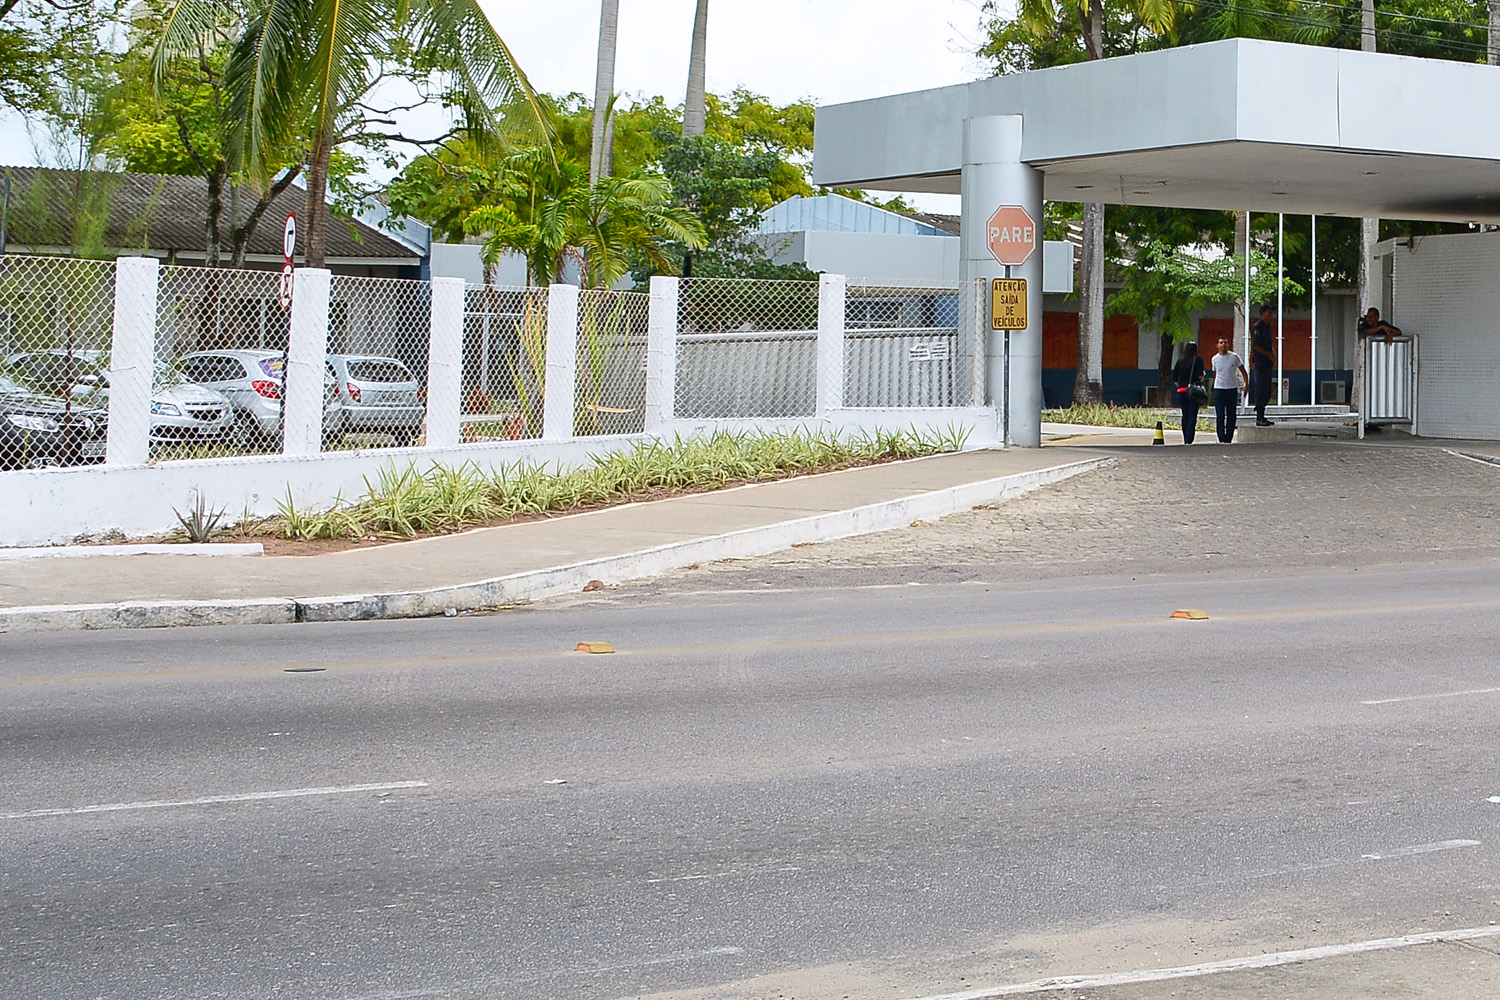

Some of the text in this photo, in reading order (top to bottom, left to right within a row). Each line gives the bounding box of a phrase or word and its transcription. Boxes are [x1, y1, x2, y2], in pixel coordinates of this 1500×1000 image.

[990, 226, 1033, 243] PARE
[993, 281, 1026, 293] ATENÇÃO
[1000, 292, 1019, 305] SAÍDA
[1005, 306, 1015, 316] DE
[993, 315, 1025, 328] VEÍCULOS
